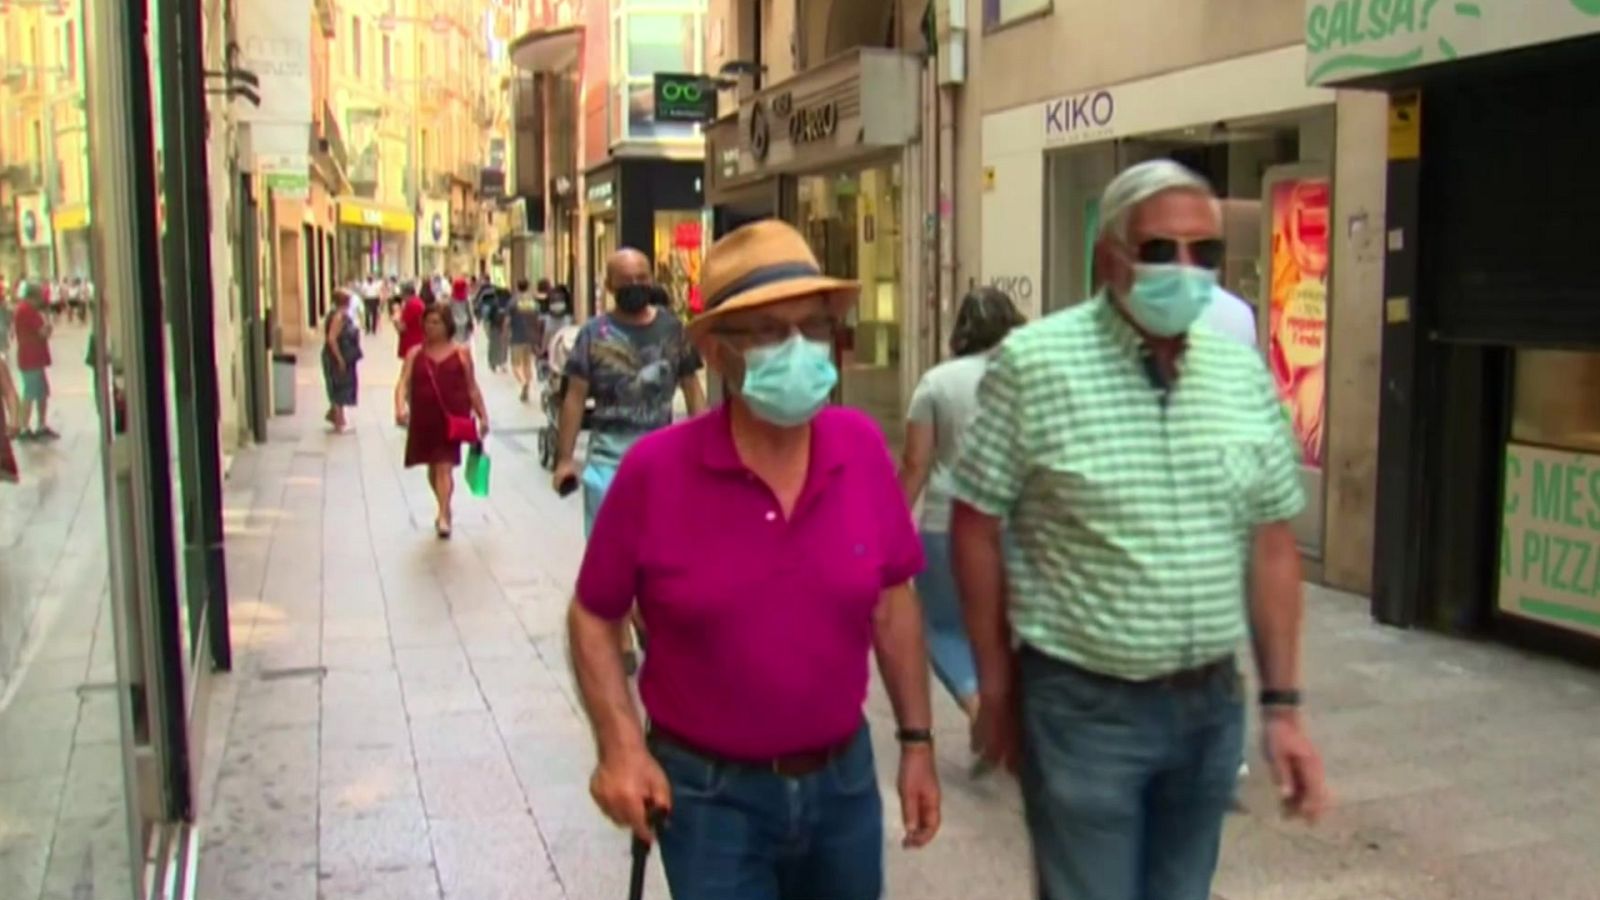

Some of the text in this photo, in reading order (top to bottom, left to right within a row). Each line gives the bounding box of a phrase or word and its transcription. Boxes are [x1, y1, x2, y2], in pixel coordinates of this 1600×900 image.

[1307, 0, 1437, 53] SALSA?
[1046, 91, 1114, 134] KIKO
[990, 275, 1033, 299] KIKO
